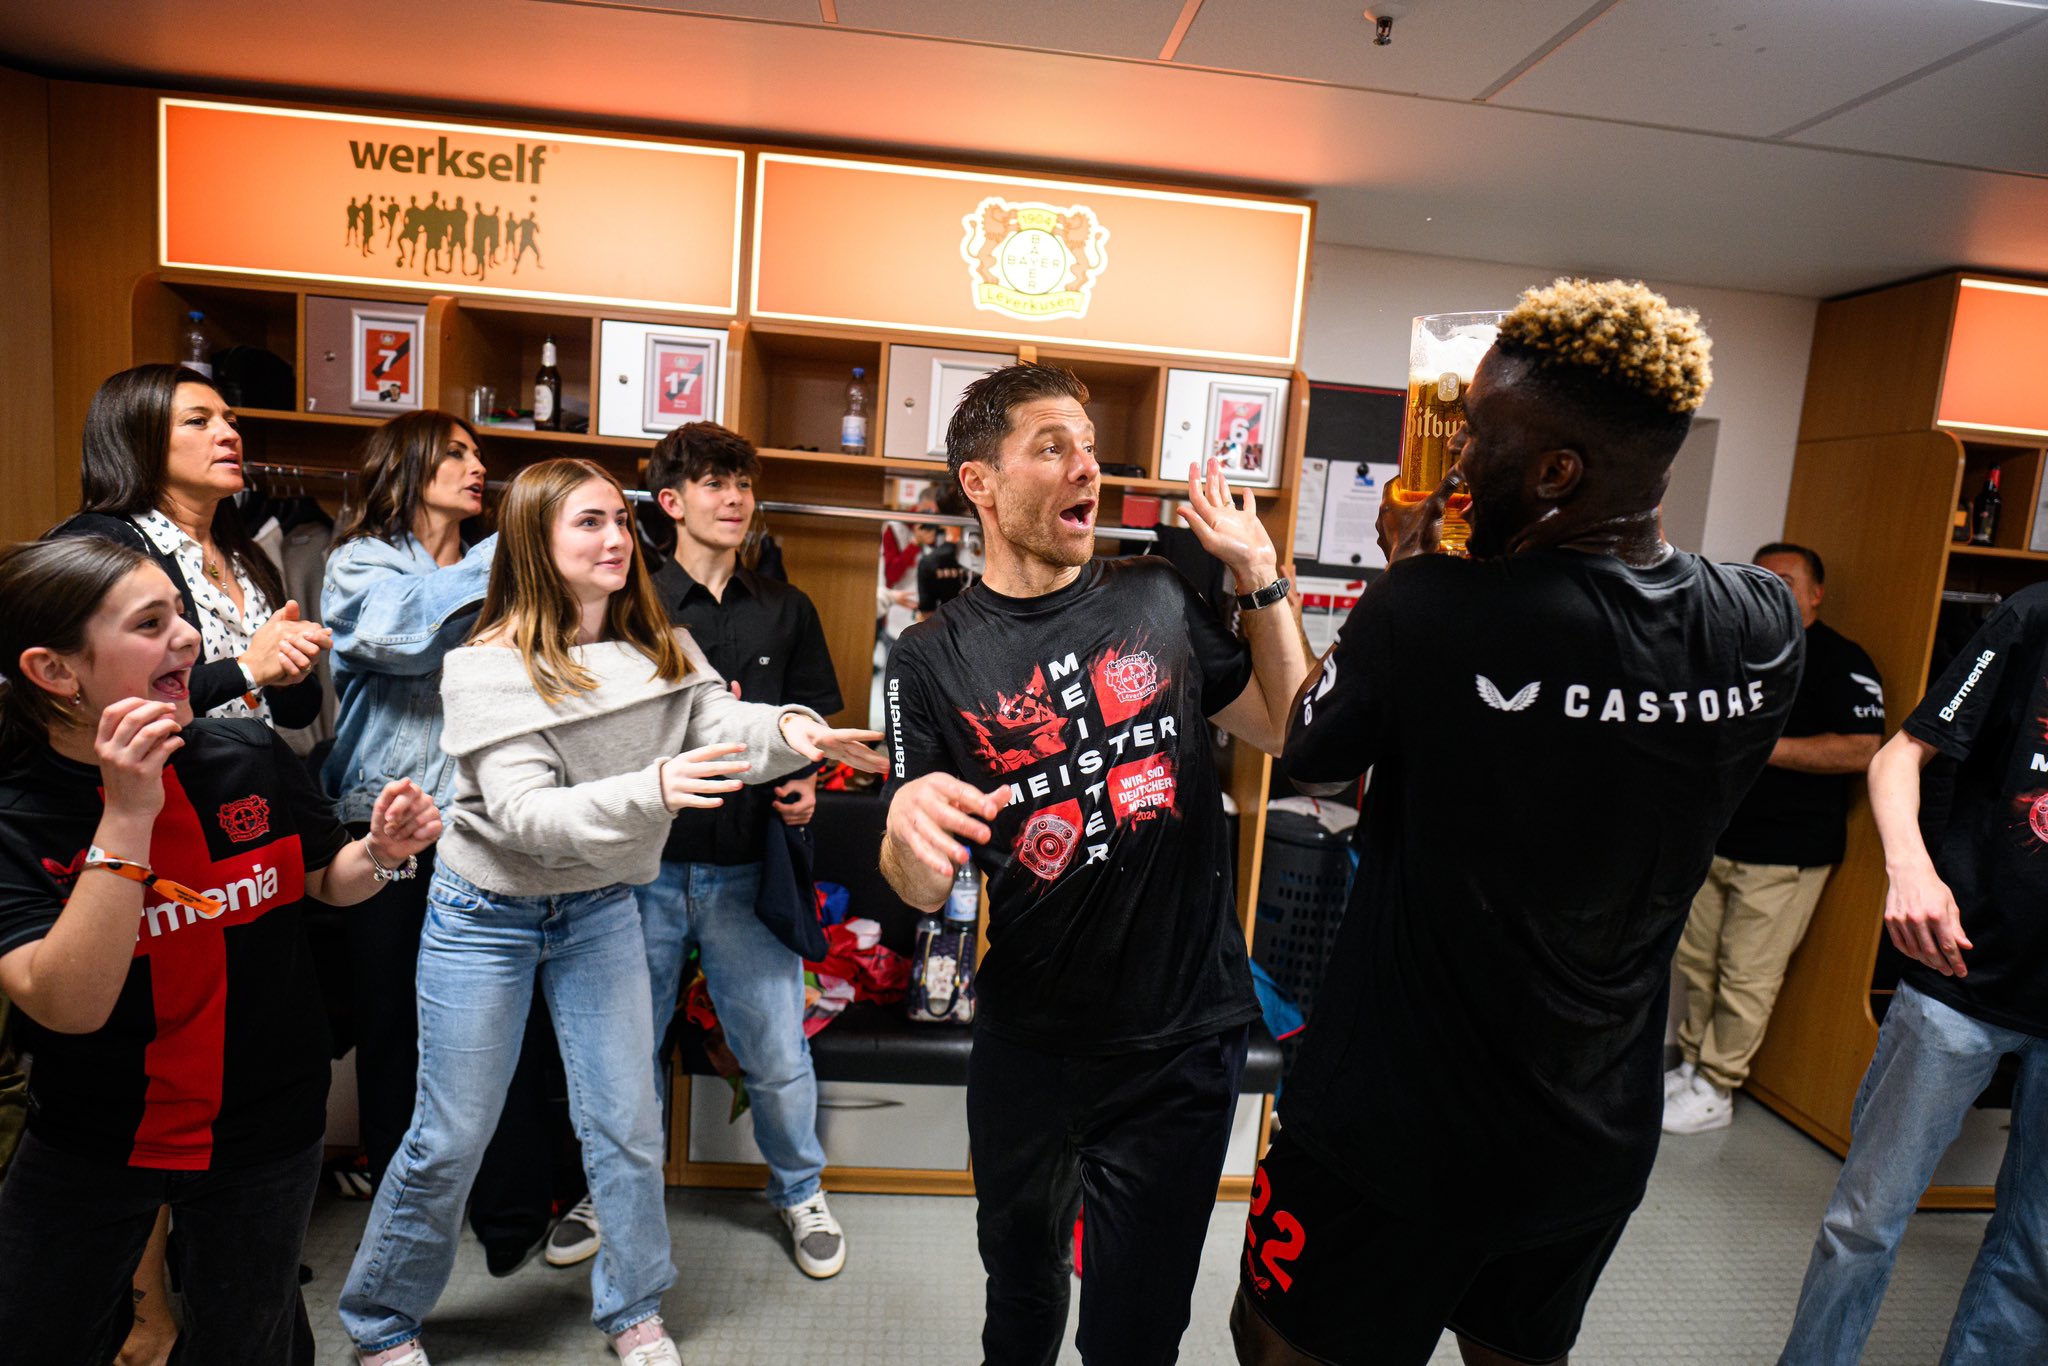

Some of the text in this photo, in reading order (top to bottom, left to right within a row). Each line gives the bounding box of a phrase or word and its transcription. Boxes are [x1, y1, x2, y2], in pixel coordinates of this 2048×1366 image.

[349, 136, 547, 184] werkself
[1021, 213, 1052, 226] 1904
[1007, 254, 1061, 269] BAYER
[986, 286, 1076, 311] Leverkusen
[378, 349, 398, 373] 7
[664, 371, 698, 396] 17
[1229, 417, 1250, 444] 6
[1122, 671, 1146, 683] BAYER
[1938, 649, 1996, 722] Barmenia
[1121, 684, 1156, 700] Leverkusen
[887, 678, 905, 778] Barmenia
[1003, 715, 1177, 808] MEISTER
[1048, 652, 1110, 865] MEISTER
[1120, 773, 1147, 790] WIR.
[1135, 809, 1157, 821] 2024
